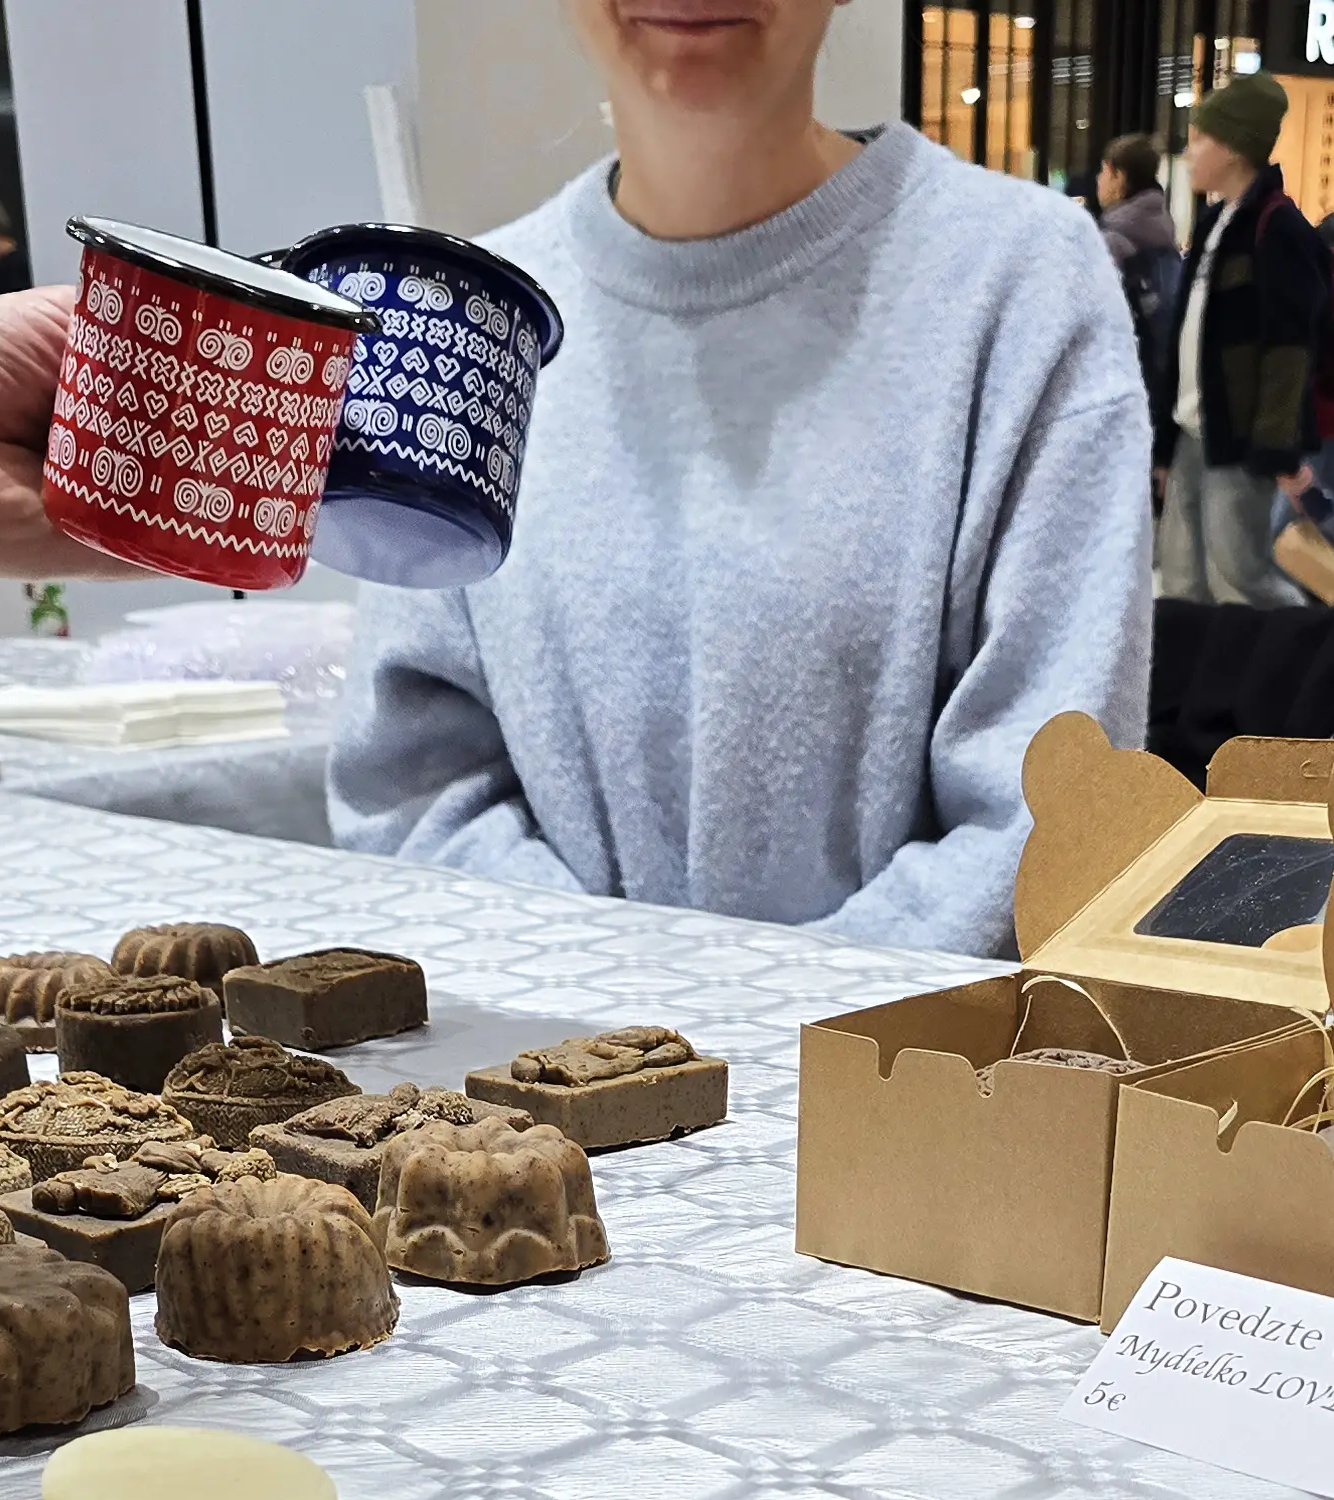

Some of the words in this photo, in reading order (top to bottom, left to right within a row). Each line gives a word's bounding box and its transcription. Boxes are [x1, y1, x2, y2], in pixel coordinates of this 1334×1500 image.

[1143, 1280, 1323, 1351] Povedzte
[1117, 1334, 1248, 1387] Mydielko
[1083, 1381, 1127, 1413] 5€
